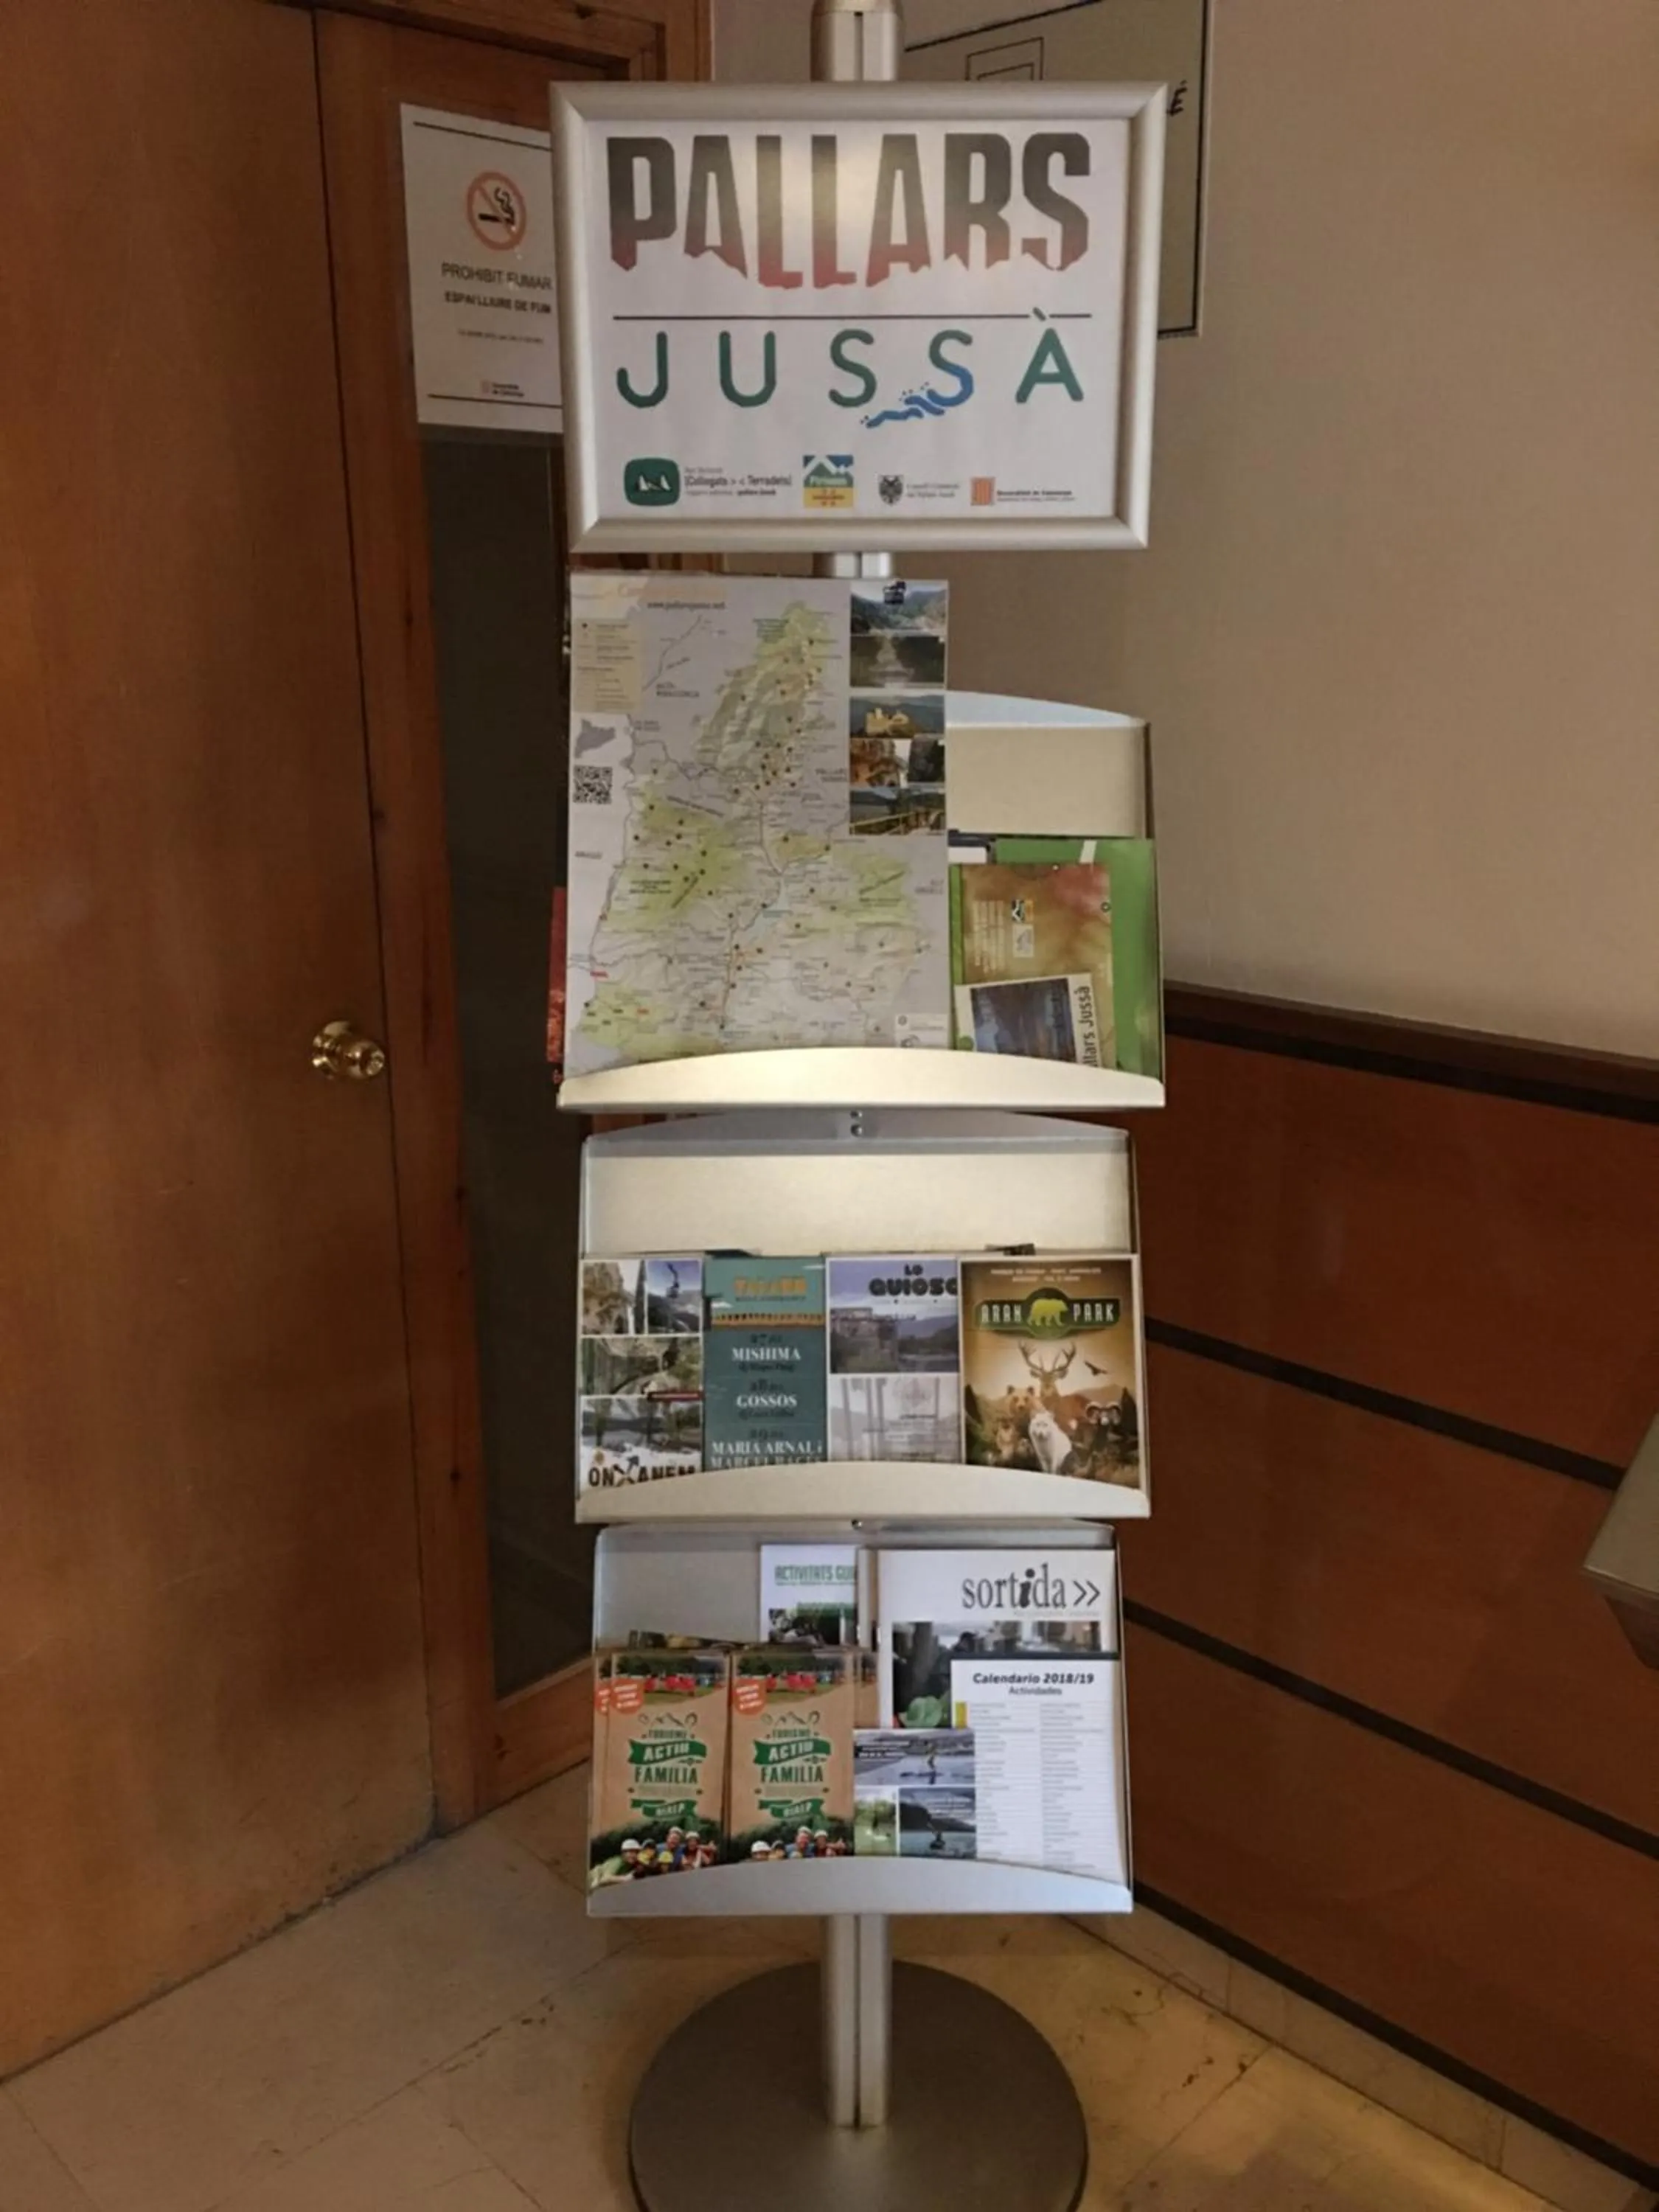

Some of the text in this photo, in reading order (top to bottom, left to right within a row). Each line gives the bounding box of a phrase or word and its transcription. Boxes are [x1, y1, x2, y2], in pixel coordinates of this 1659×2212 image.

[606, 132, 1091, 290] PALLARS
[442, 262, 552, 290] PROHIBIT FUMAR
[616, 307, 1085, 408] JUSSÀ
[1074, 985, 1095, 1029] Jussà
[904, 1263, 924, 1276] LO
[1073, 1302, 1115, 1322] PARK
[731, 1347, 801, 1362] MISHIMA
[736, 1394, 798, 1408] GOSSOS
[712, 1441, 761, 1455] MARIA
[765, 1440, 813, 1454] ARNAL
[774, 1565, 832, 1580] ACTIVITATS
[961, 1561, 1067, 1609] sortida
[972, 1672, 1095, 1685] Calendario 2018/19
[1008, 1686, 1062, 1695] Actividades
[635, 1766, 698, 1784] FAMILIA
[760, 1766, 824, 1784] FAMILIA
